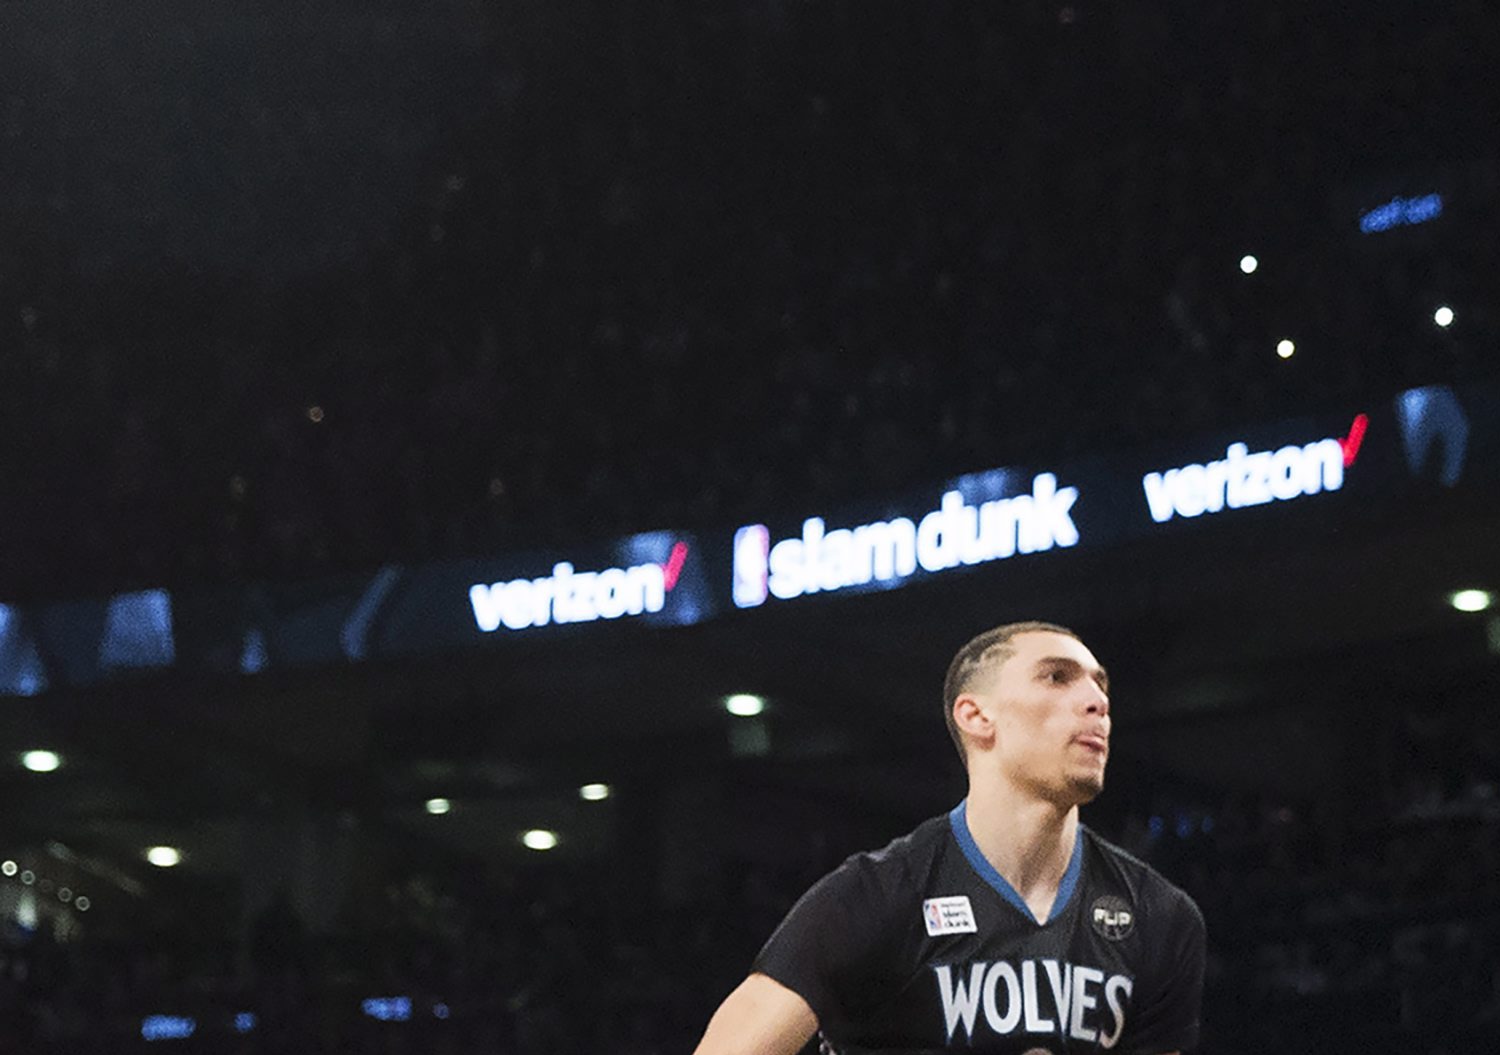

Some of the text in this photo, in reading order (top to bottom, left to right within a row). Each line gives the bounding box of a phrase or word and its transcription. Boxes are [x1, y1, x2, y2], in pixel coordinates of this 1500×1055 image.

[1142, 438, 1344, 523] verizon
[768, 516, 917, 599] slam
[917, 472, 1080, 572] dunk
[469, 561, 664, 632] verizon
[932, 959, 1133, 1049] WOLVES
